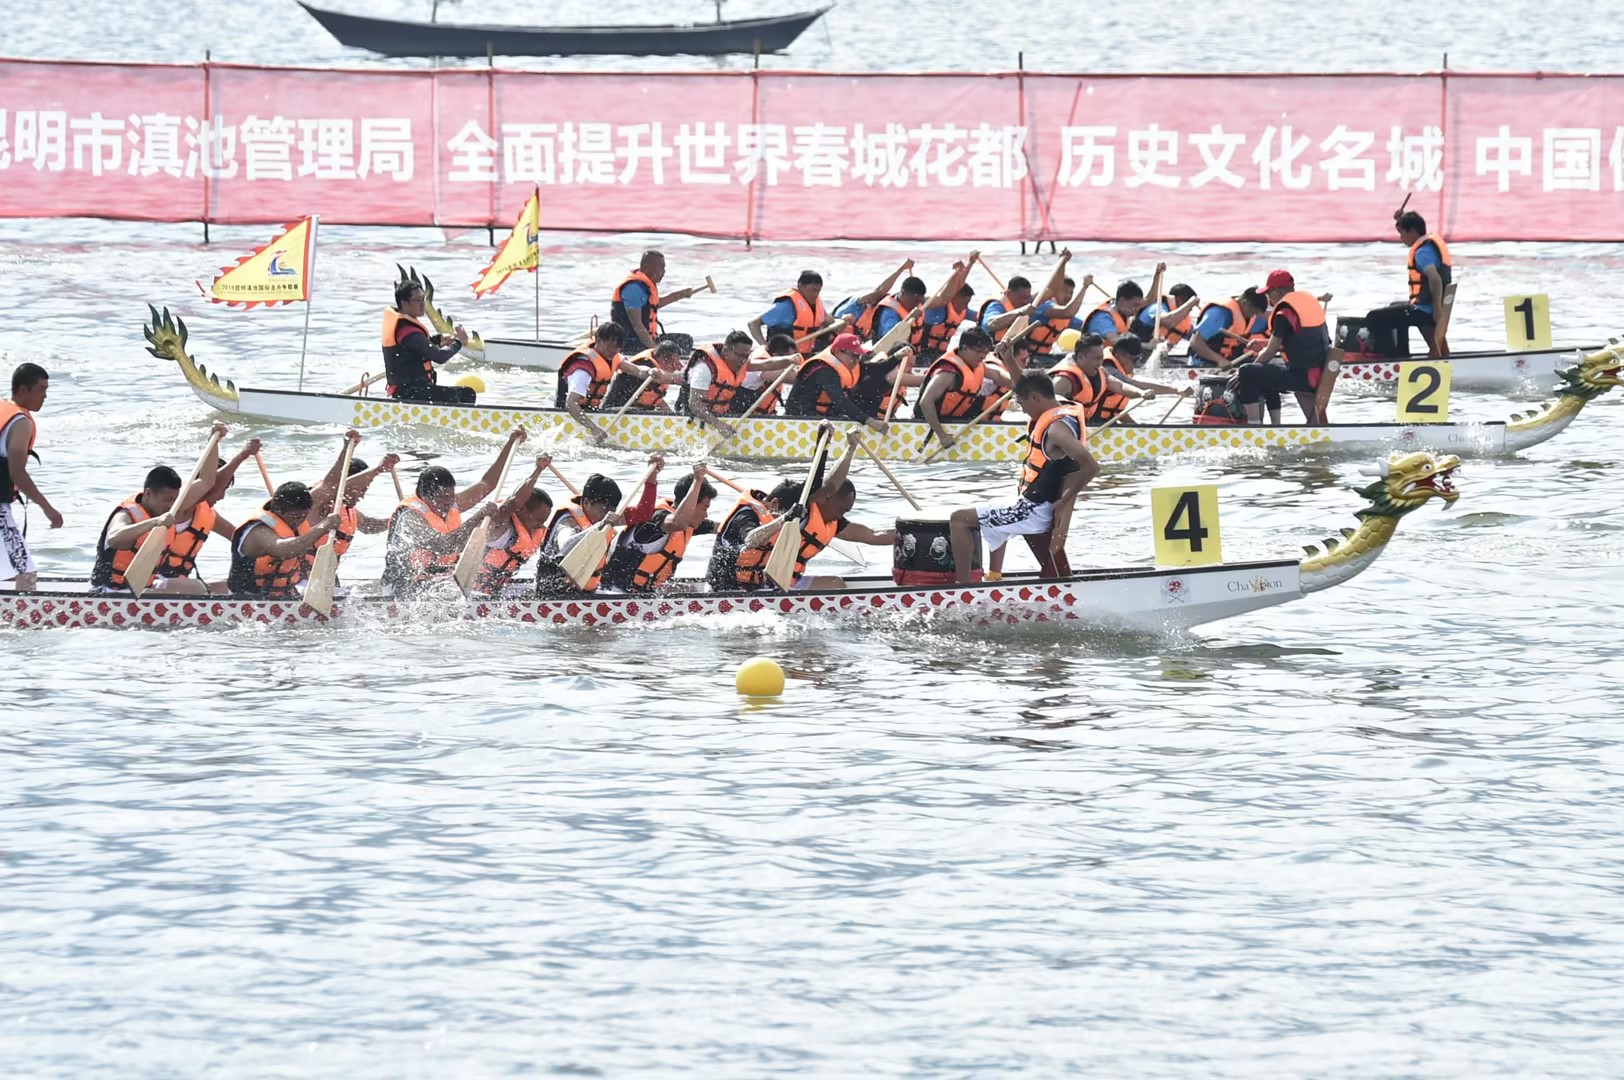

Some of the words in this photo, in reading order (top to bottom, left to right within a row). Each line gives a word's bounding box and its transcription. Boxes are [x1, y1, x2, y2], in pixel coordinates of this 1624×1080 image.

[0, 108, 414, 181] 明市滇池管理局
[447, 119, 1028, 188] 全面提升世界春城花都
[1057, 123, 1445, 192] 历史文化名城
[1476, 125, 1624, 192] 中国
[1514, 298, 1535, 340] 1
[1405, 366, 1441, 413] 2
[1164, 491, 1208, 552] 4
